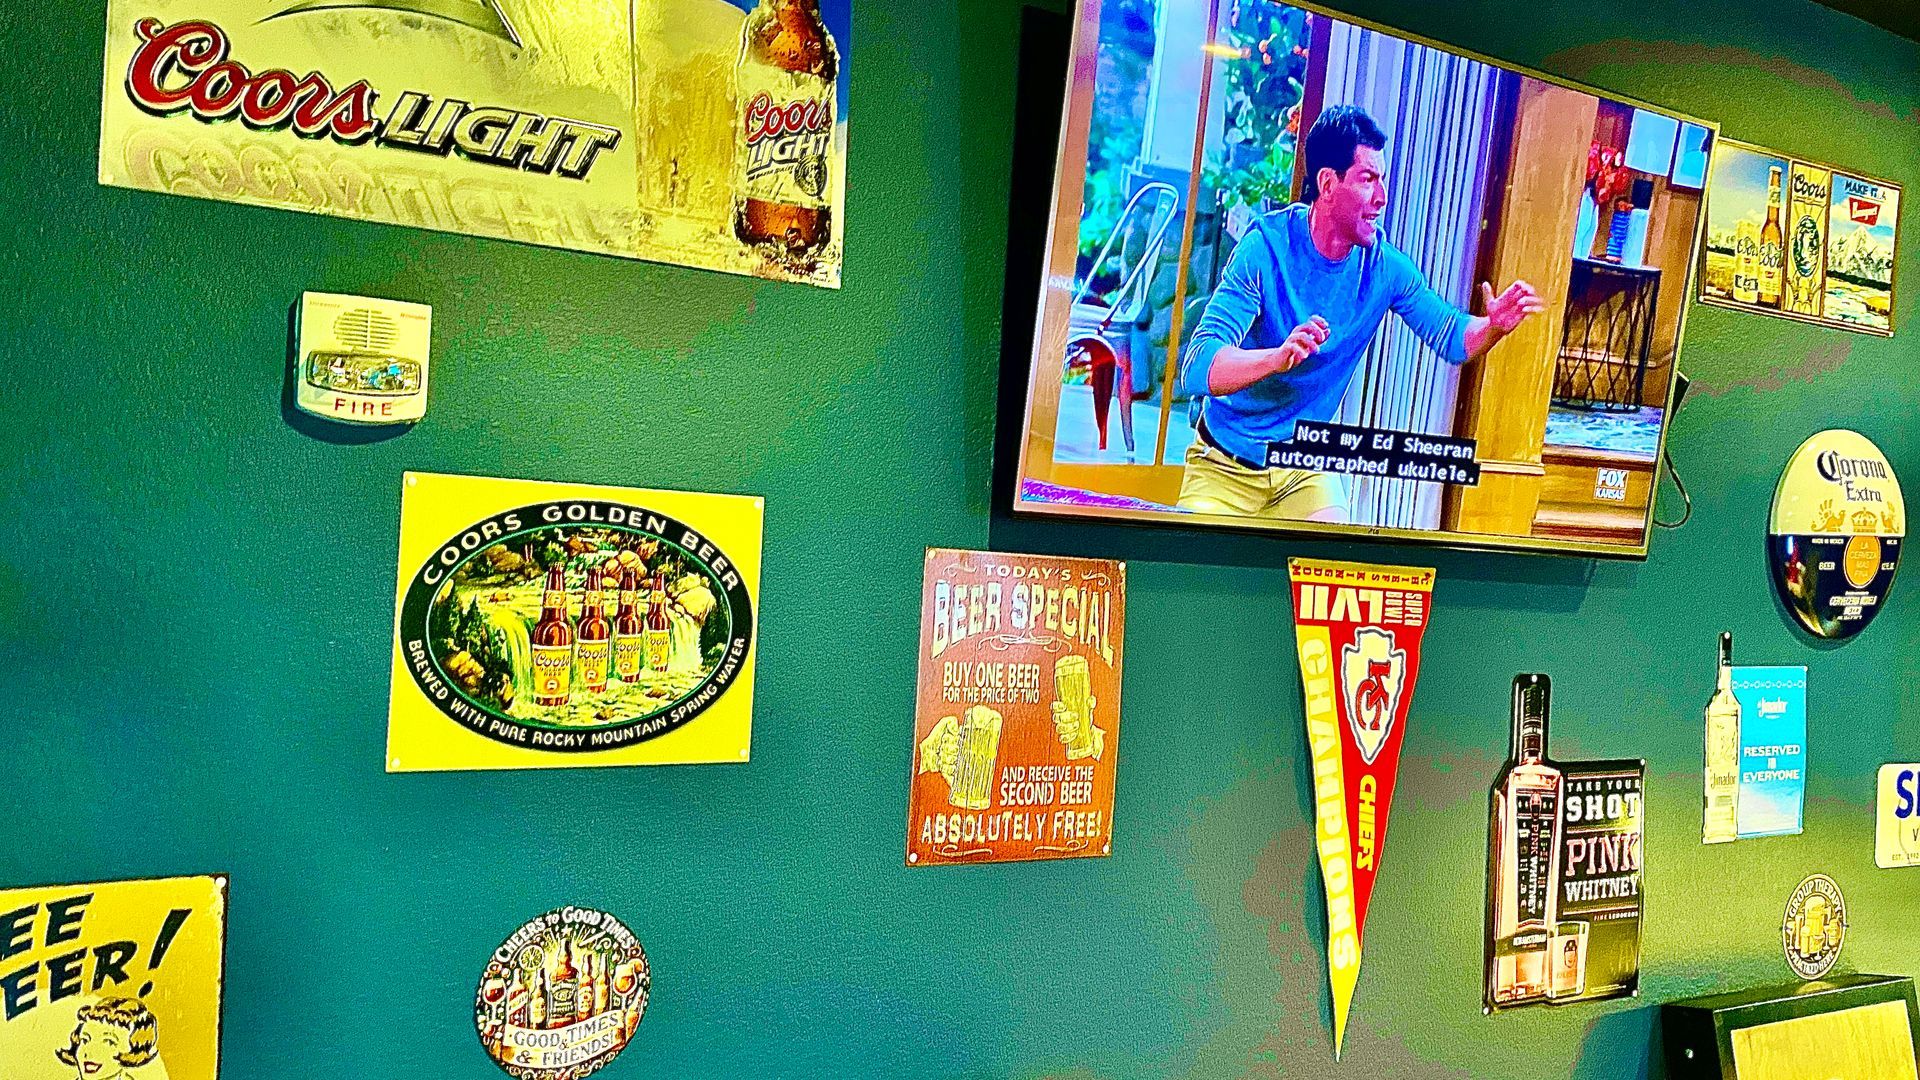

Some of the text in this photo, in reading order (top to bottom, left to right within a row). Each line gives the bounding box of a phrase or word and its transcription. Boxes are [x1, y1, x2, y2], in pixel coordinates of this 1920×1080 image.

[126, 18, 622, 180] Coors LIGHT
[745, 89, 832, 142] Coors
[746, 132, 830, 176] LIGHT
[1793, 173, 1827, 198] Coors
[1845, 180, 1869, 195] MAKE
[334, 397, 393, 416] FIRE
[1297, 425, 1473, 460] Not my Ed Sheeran
[1269, 450, 1475, 483] autographed ukulele.
[1598, 468, 1628, 487] FOX
[1816, 450, 1888, 486] Corona
[1844, 480, 1883, 502] Extra
[422, 503, 740, 592] COORS GOLDEN BEER
[984, 563, 1072, 581] TODAY'S
[1292, 564, 1432, 586] CHIEFS KINGDOM
[1299, 584, 1384, 624] LVII
[1383, 590, 1403, 625] BOWL
[1404, 592, 1423, 627] SUPER
[931, 579, 1115, 670] BEER SPECIAL
[408, 636, 746, 747] BREWED WITH PURE ROCKY MOUNTAIN SPRING WATER
[943, 661, 1041, 689] BUY ONE BEER
[942, 686, 1040, 704] FOR THE PRICE OF TWO
[1743, 744, 1801, 758] RESERVED
[1001, 765, 1094, 783] AND RECEIVE THE
[1567, 778, 1640, 793] TAKE YOUR
[1742, 769, 1800, 784] EVERYONE
[999, 782, 1093, 806] SECOND BEER
[1301, 638, 1357, 971] CHAMPIONS
[1566, 792, 1641, 823] SHOT
[921, 809, 1102, 844] ABSOLUTELY FREE!
[1356, 774, 1377, 872] CHIEFS
[1527, 823, 1540, 915] PINK WHITNEY
[1565, 832, 1640, 877] PINK
[1564, 875, 1640, 903] WHITNEY
[1788, 878, 1842, 918] GROUP THERAPY
[495, 905, 636, 963] CHEERS TO GOOD TIMES
[513, 1030, 561, 1048] GOOD
[565, 1012, 619, 1043] TIMES
[516, 1029, 614, 1066] & FRIENDS!
